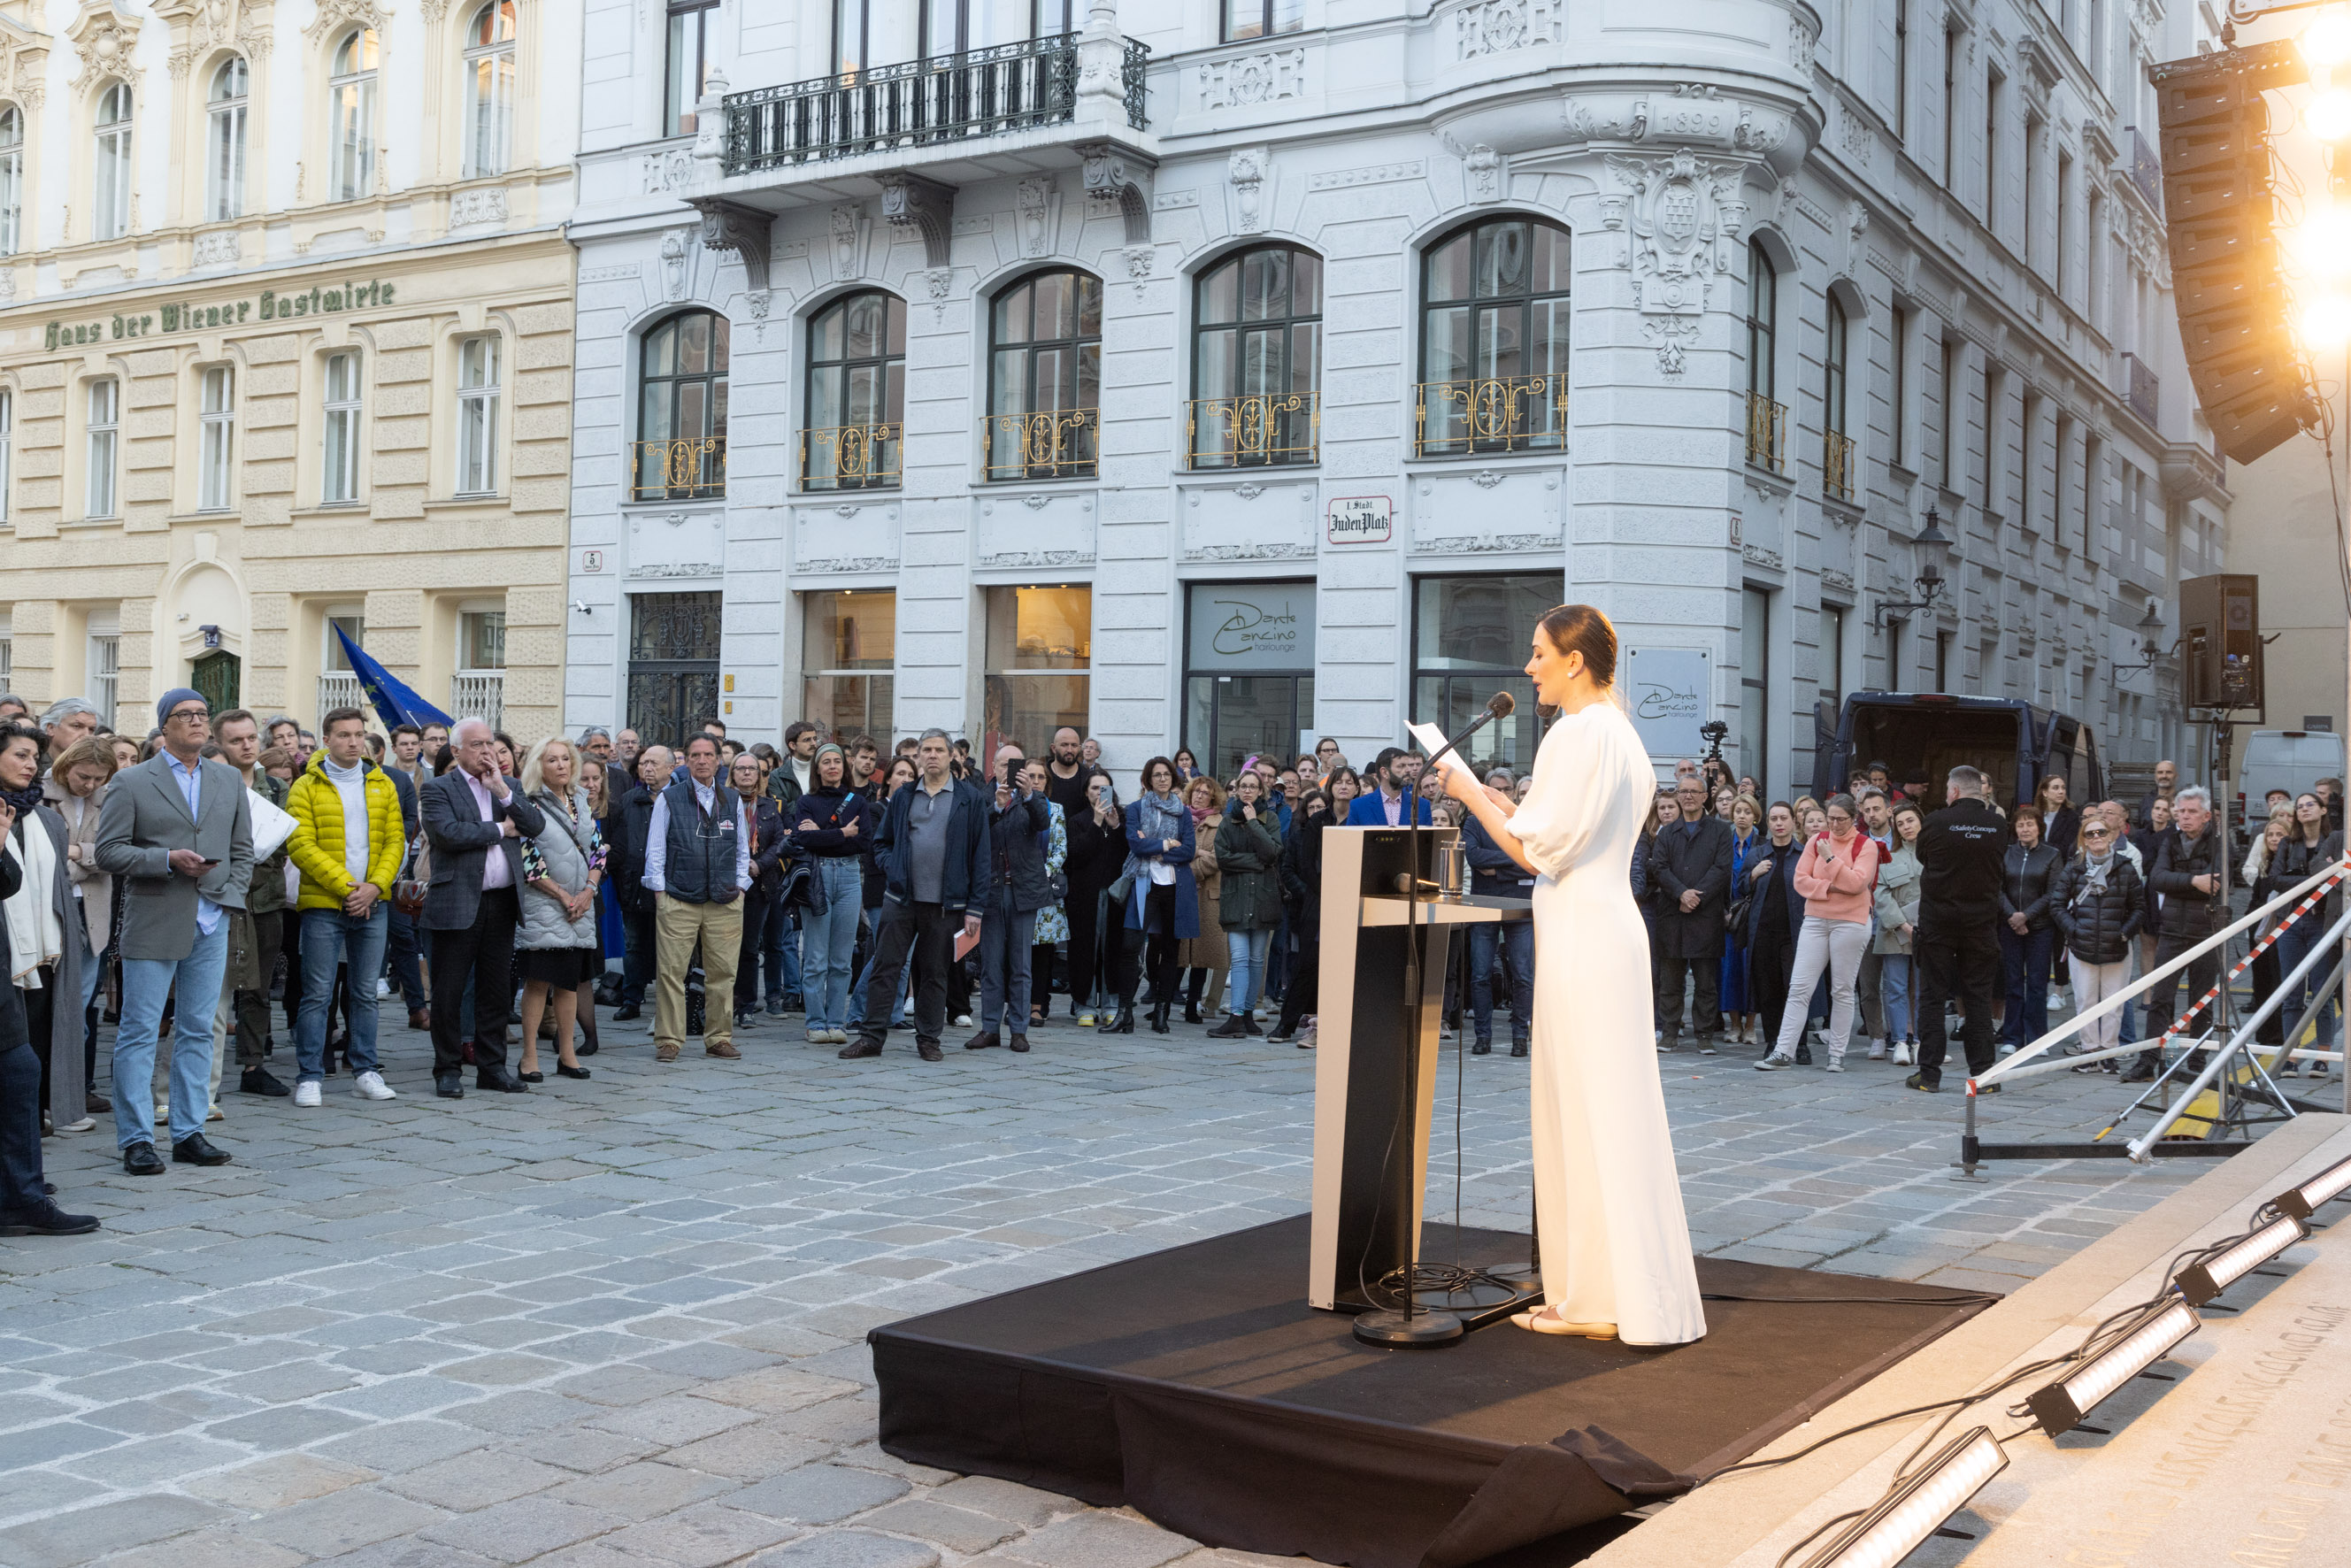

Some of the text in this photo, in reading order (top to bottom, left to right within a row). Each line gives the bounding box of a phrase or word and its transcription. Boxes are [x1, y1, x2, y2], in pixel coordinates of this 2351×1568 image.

[1662, 111, 1720, 135] 1899
[44, 279, 396, 352] Haus der Wiener Gastwirte
[1214, 600, 1296, 632] Dante
[1212, 615, 1296, 655] Cancino
[1255, 642, 1295, 651] hairlounge
[1638, 682, 1698, 703] Dante
